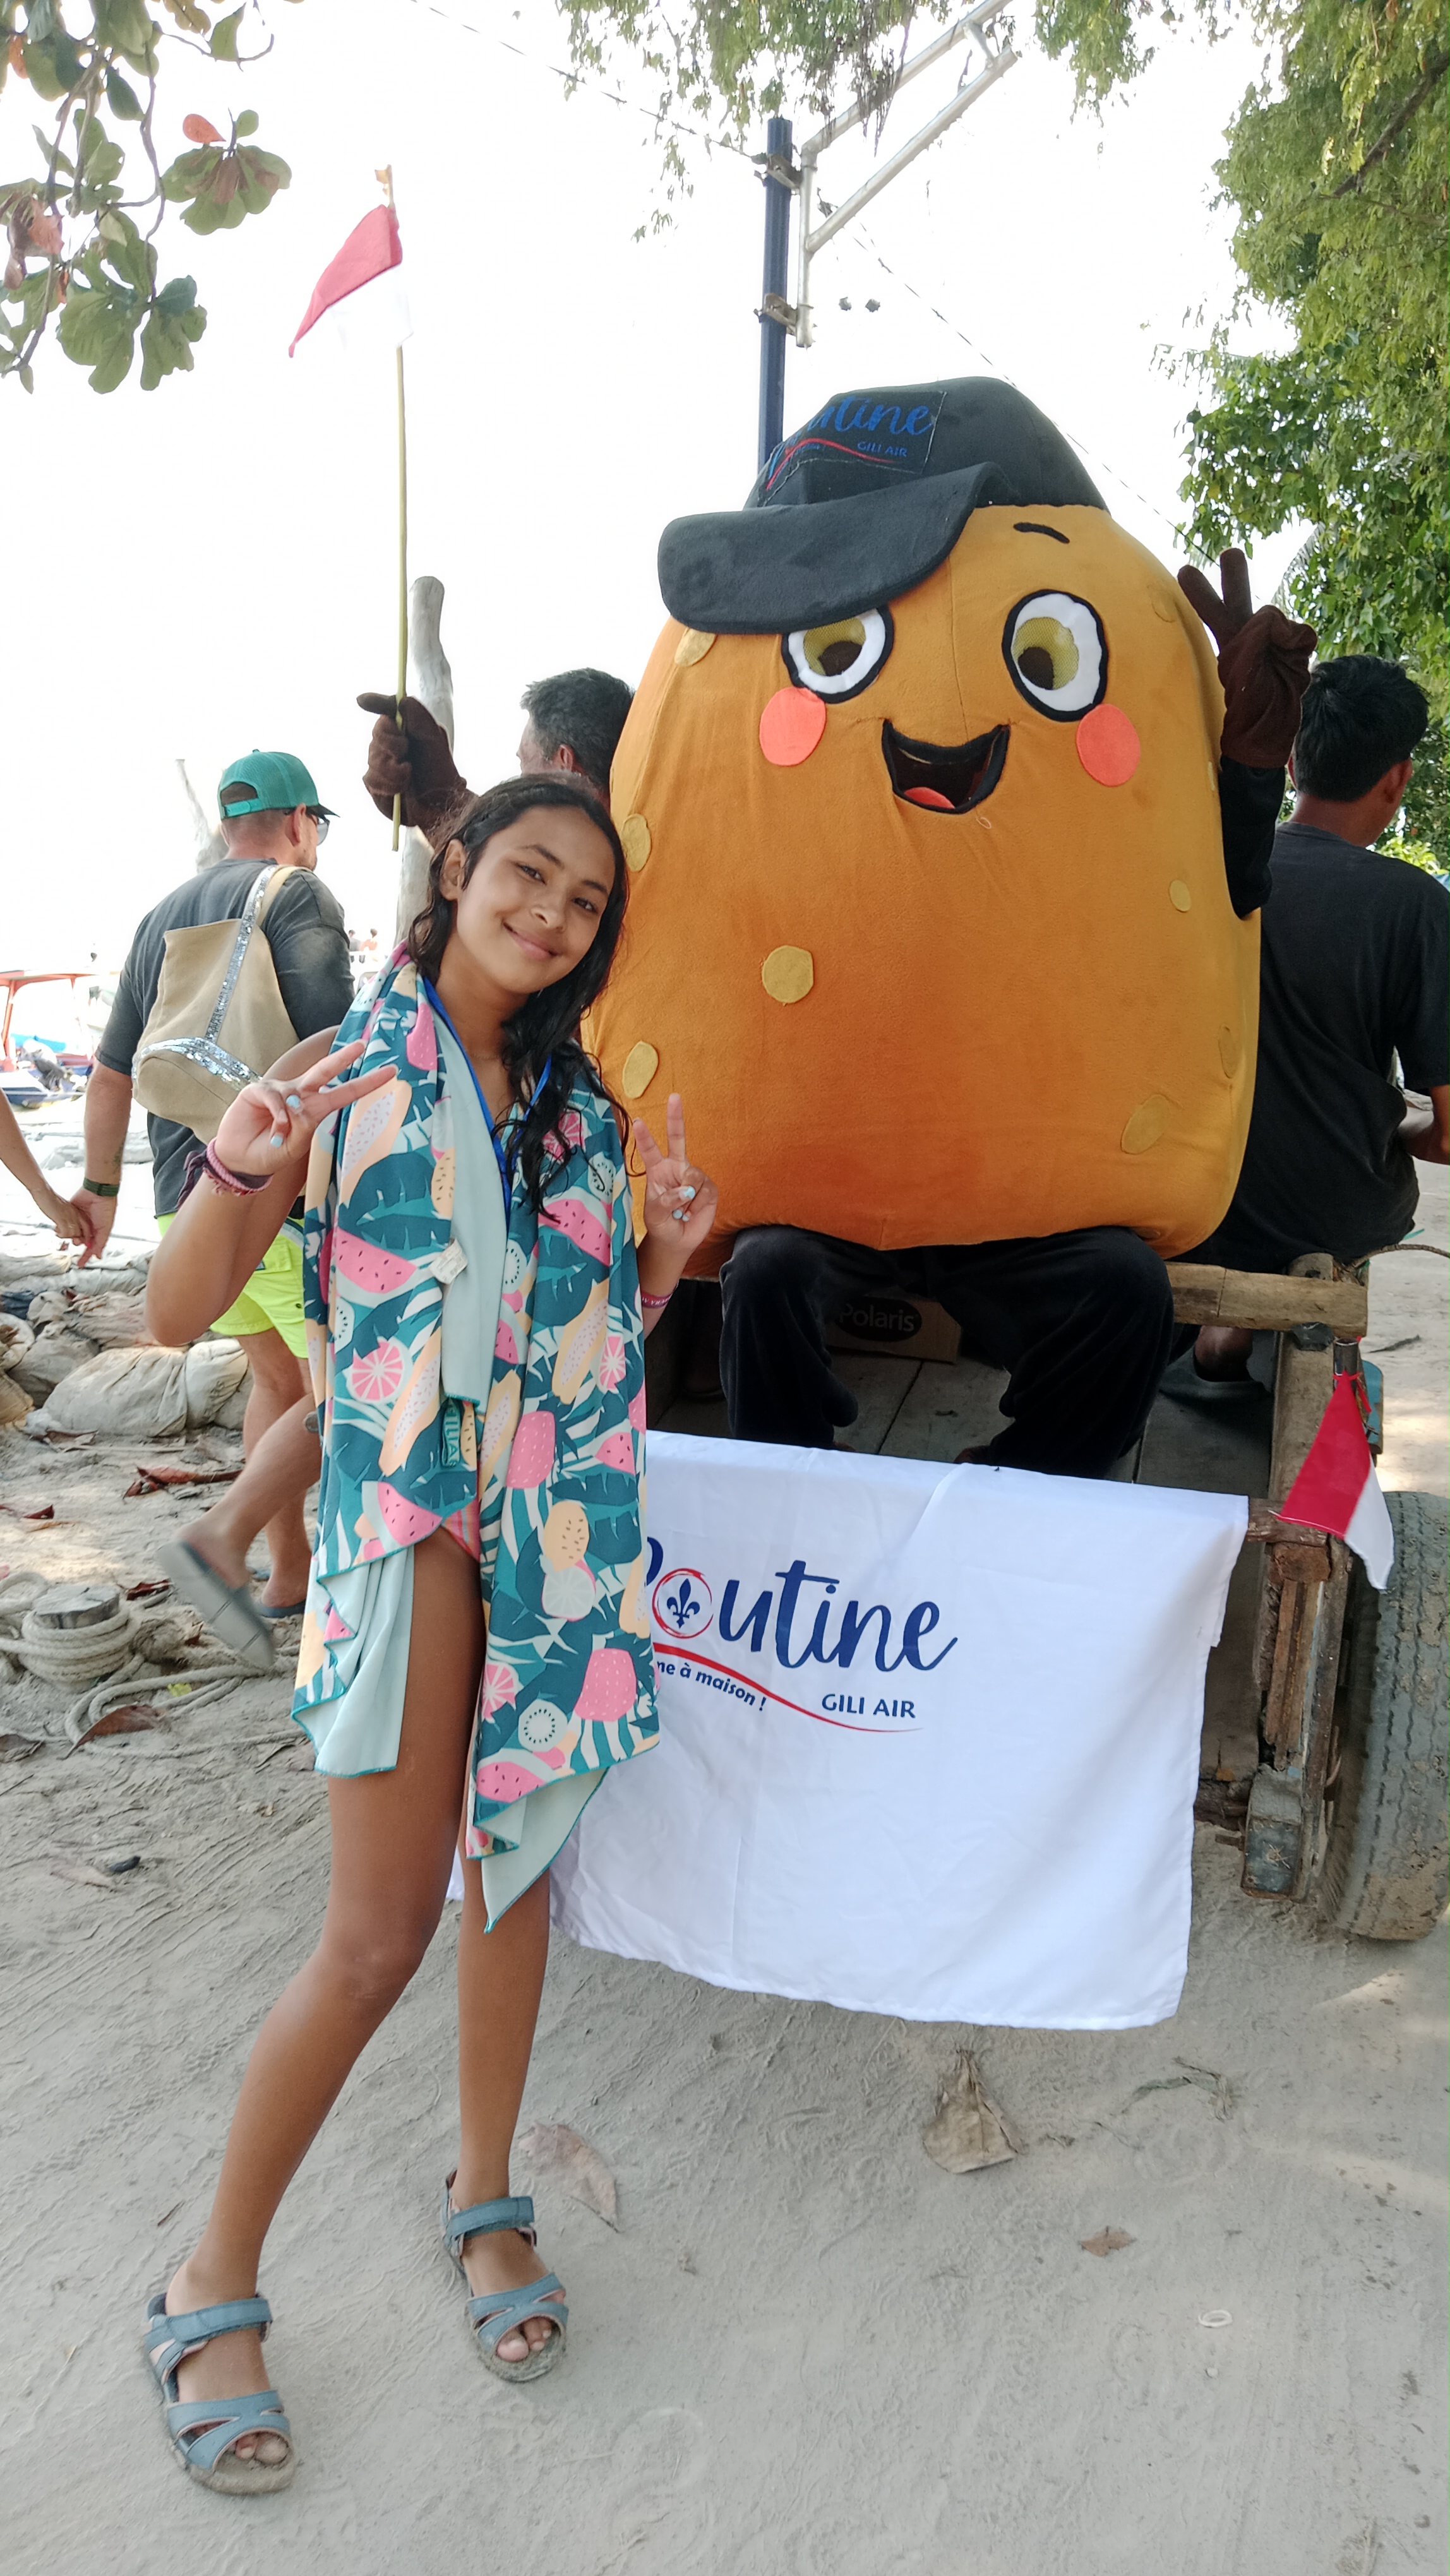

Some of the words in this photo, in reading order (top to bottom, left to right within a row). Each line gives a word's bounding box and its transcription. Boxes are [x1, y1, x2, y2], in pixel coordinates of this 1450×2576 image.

[857, 441, 883, 453] GILI
[885, 446, 908, 458] AIR
[839, 1303, 915, 1333] Polaris
[680, 1662, 692, 1678] à
[695, 1671, 755, 1705] maison
[822, 1693, 865, 1714] GILI
[873, 1699, 916, 1718] AIR
